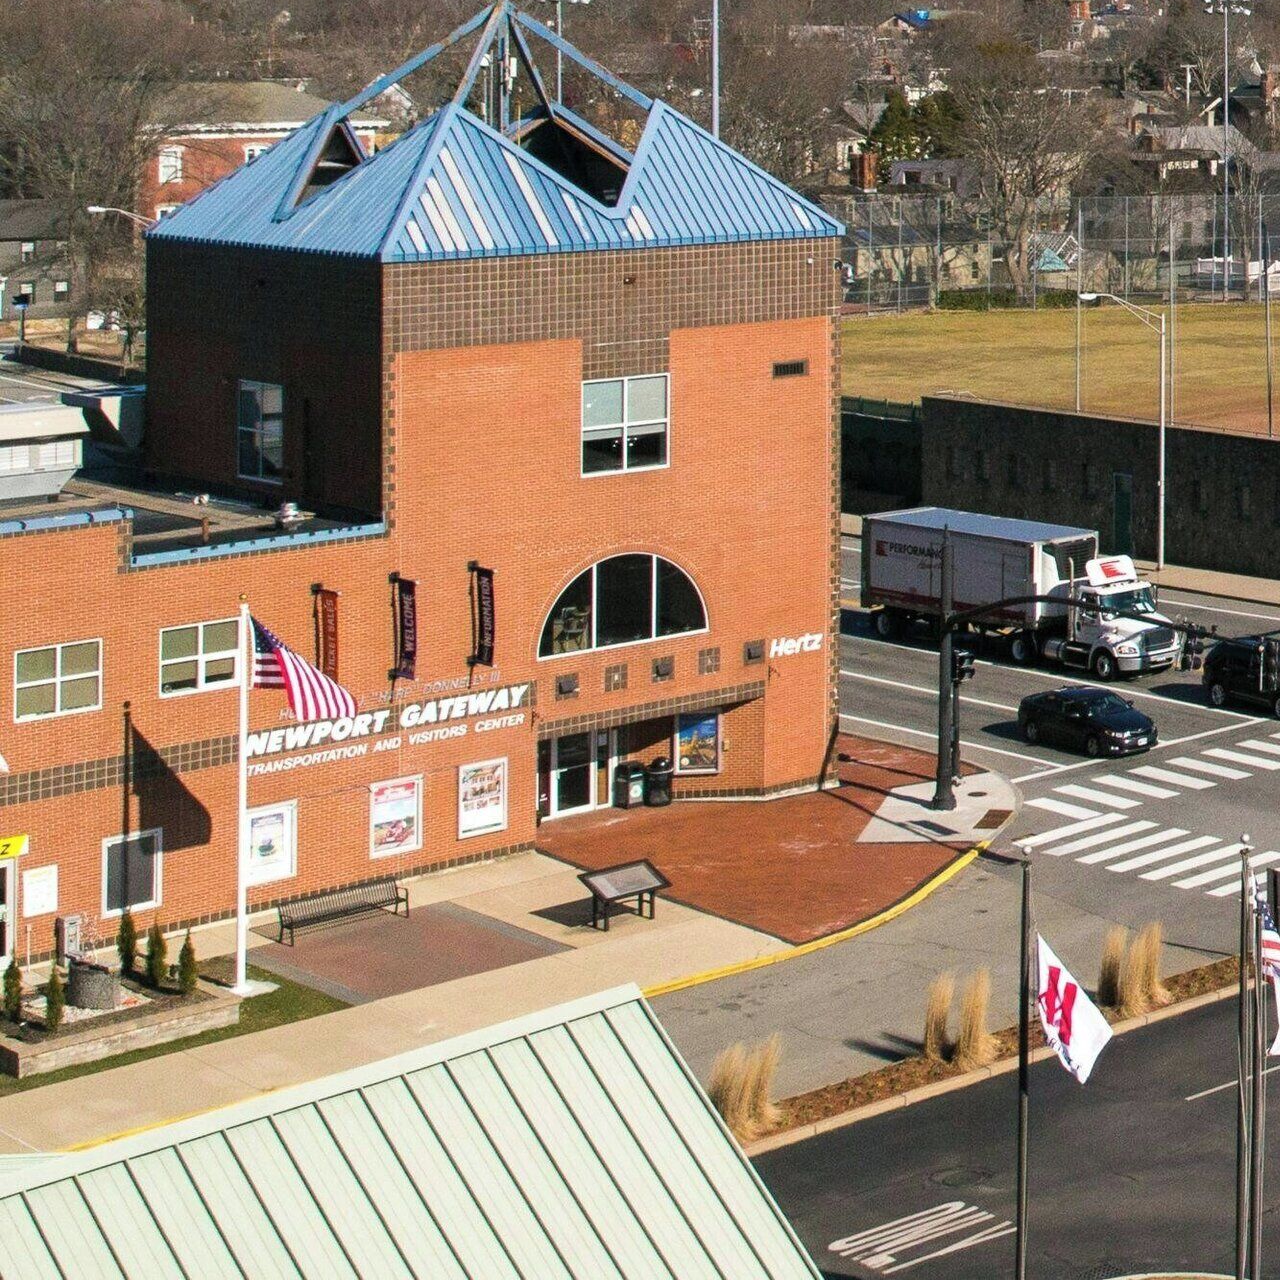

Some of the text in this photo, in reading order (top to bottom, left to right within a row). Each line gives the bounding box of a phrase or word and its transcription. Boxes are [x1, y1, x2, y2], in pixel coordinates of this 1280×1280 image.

[889, 542, 944, 559] PERFORMANC
[404, 594, 414, 651] WELCOME
[482, 577, 492, 647] INFORMATION
[769, 632, 824, 660] Hertz
[246, 684, 529, 757] NEWPORT GATEWAY
[246, 713, 525, 777] TRANSPORTATION AND VISITORS CENTER
[828, 1200, 1017, 1275] ONLY
